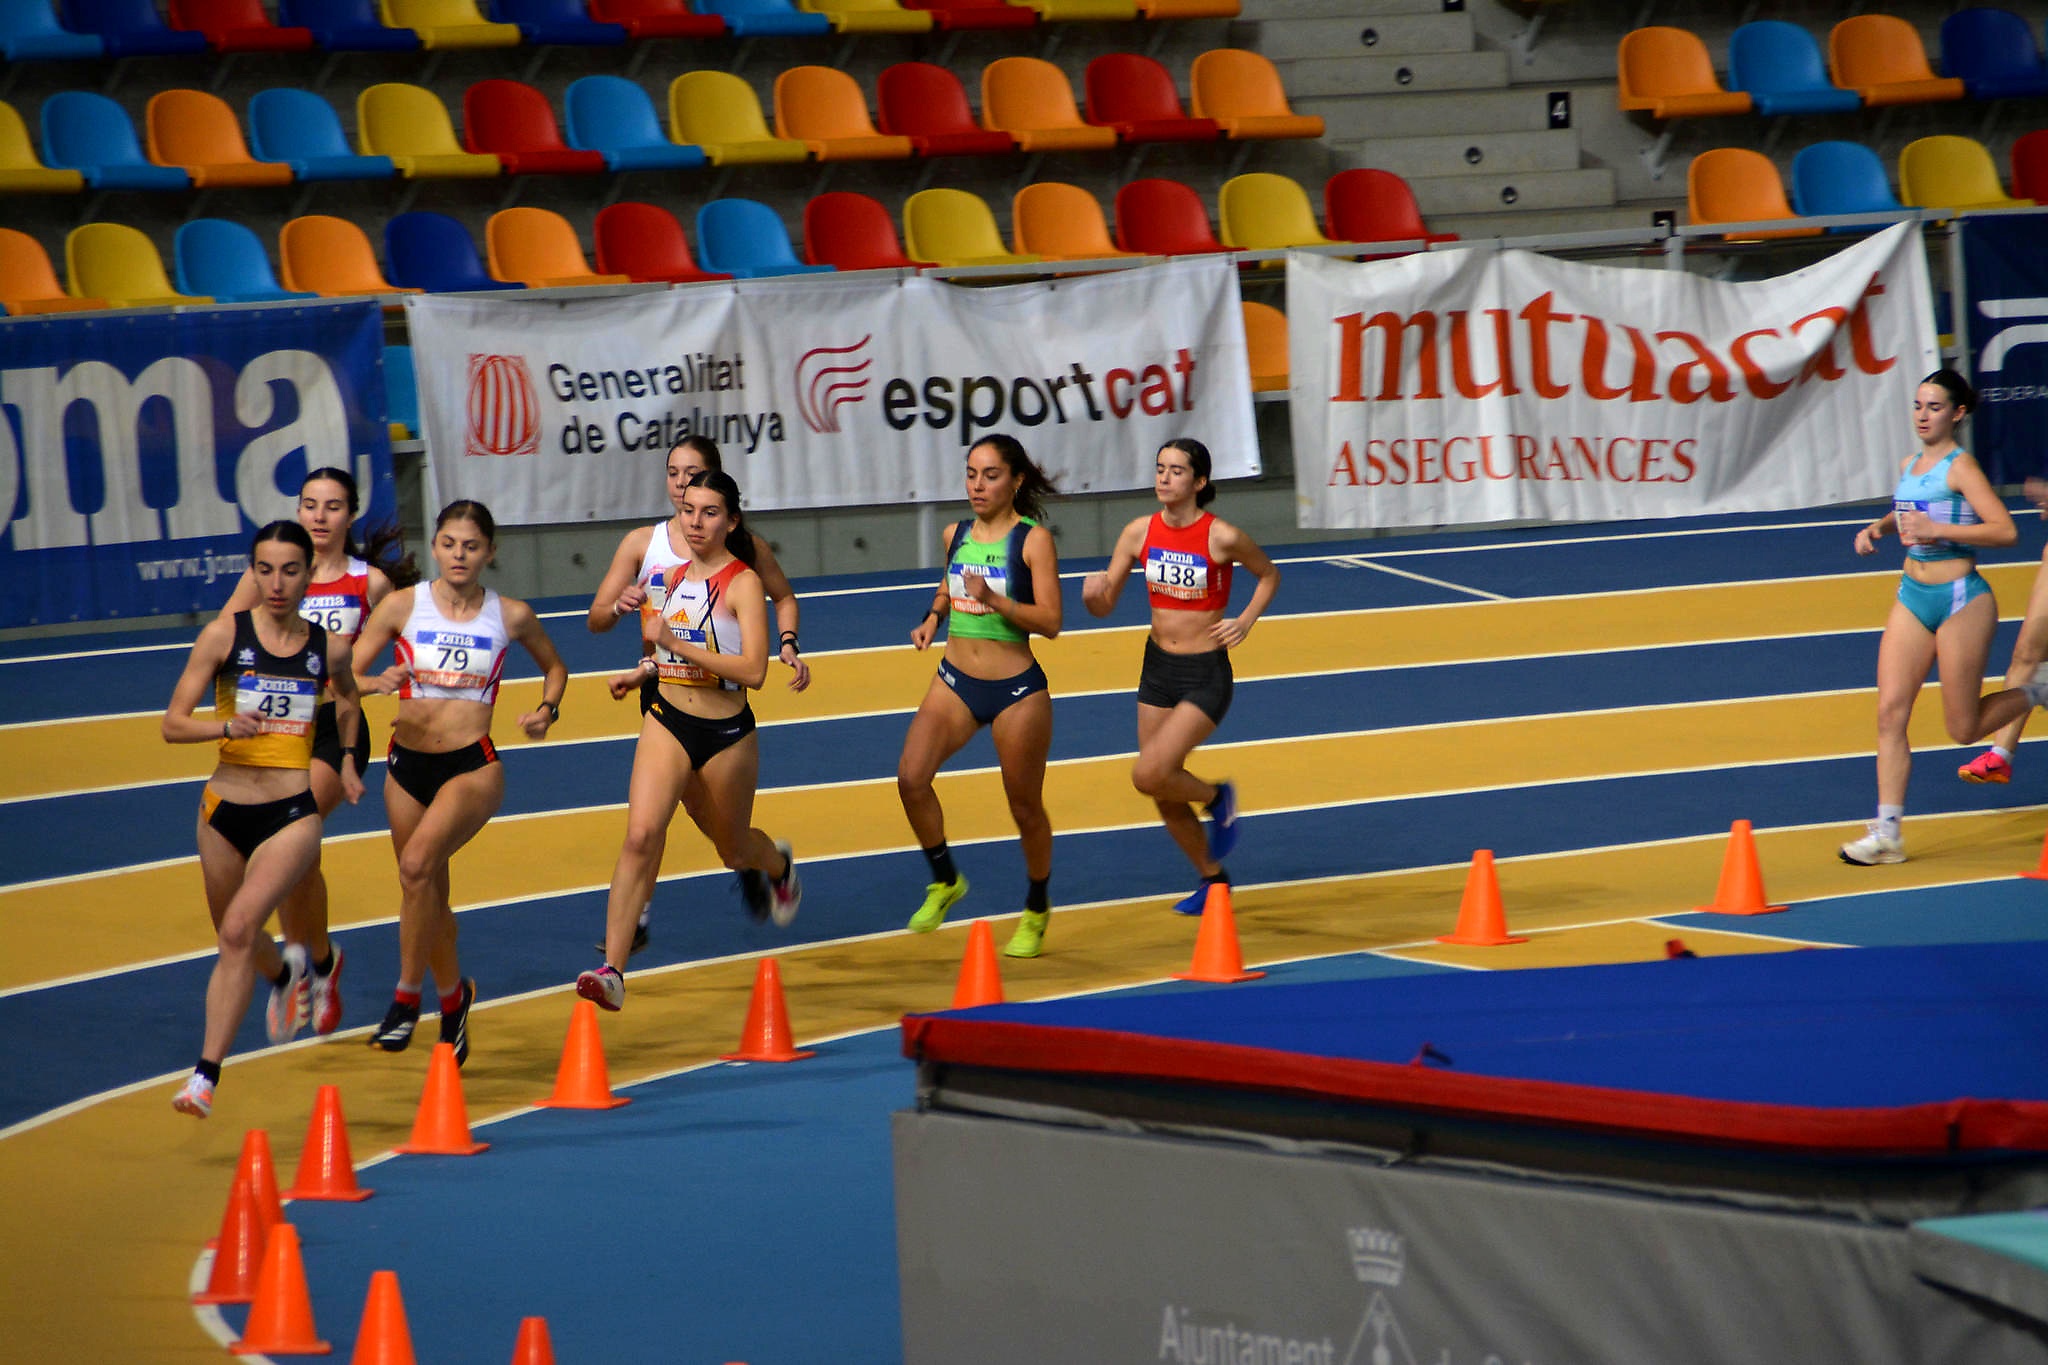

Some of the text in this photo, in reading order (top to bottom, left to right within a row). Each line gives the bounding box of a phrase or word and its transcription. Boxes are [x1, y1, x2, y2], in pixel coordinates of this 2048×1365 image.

[1552, 101, 1567, 120] 4
[1328, 270, 1898, 403] mutuacat
[548, 352, 746, 401] Generalitat
[883, 348, 1196, 446] esportcat
[0, 350, 372, 551] ma
[561, 406, 786, 454] de Catalunya
[1328, 434, 1699, 486] ASSEGURANCES
[1157, 564, 1196, 587] 138
[437, 647, 469, 671] 79
[258, 695, 291, 717] 43
[1159, 1304, 1335, 1365] Ajuntament
